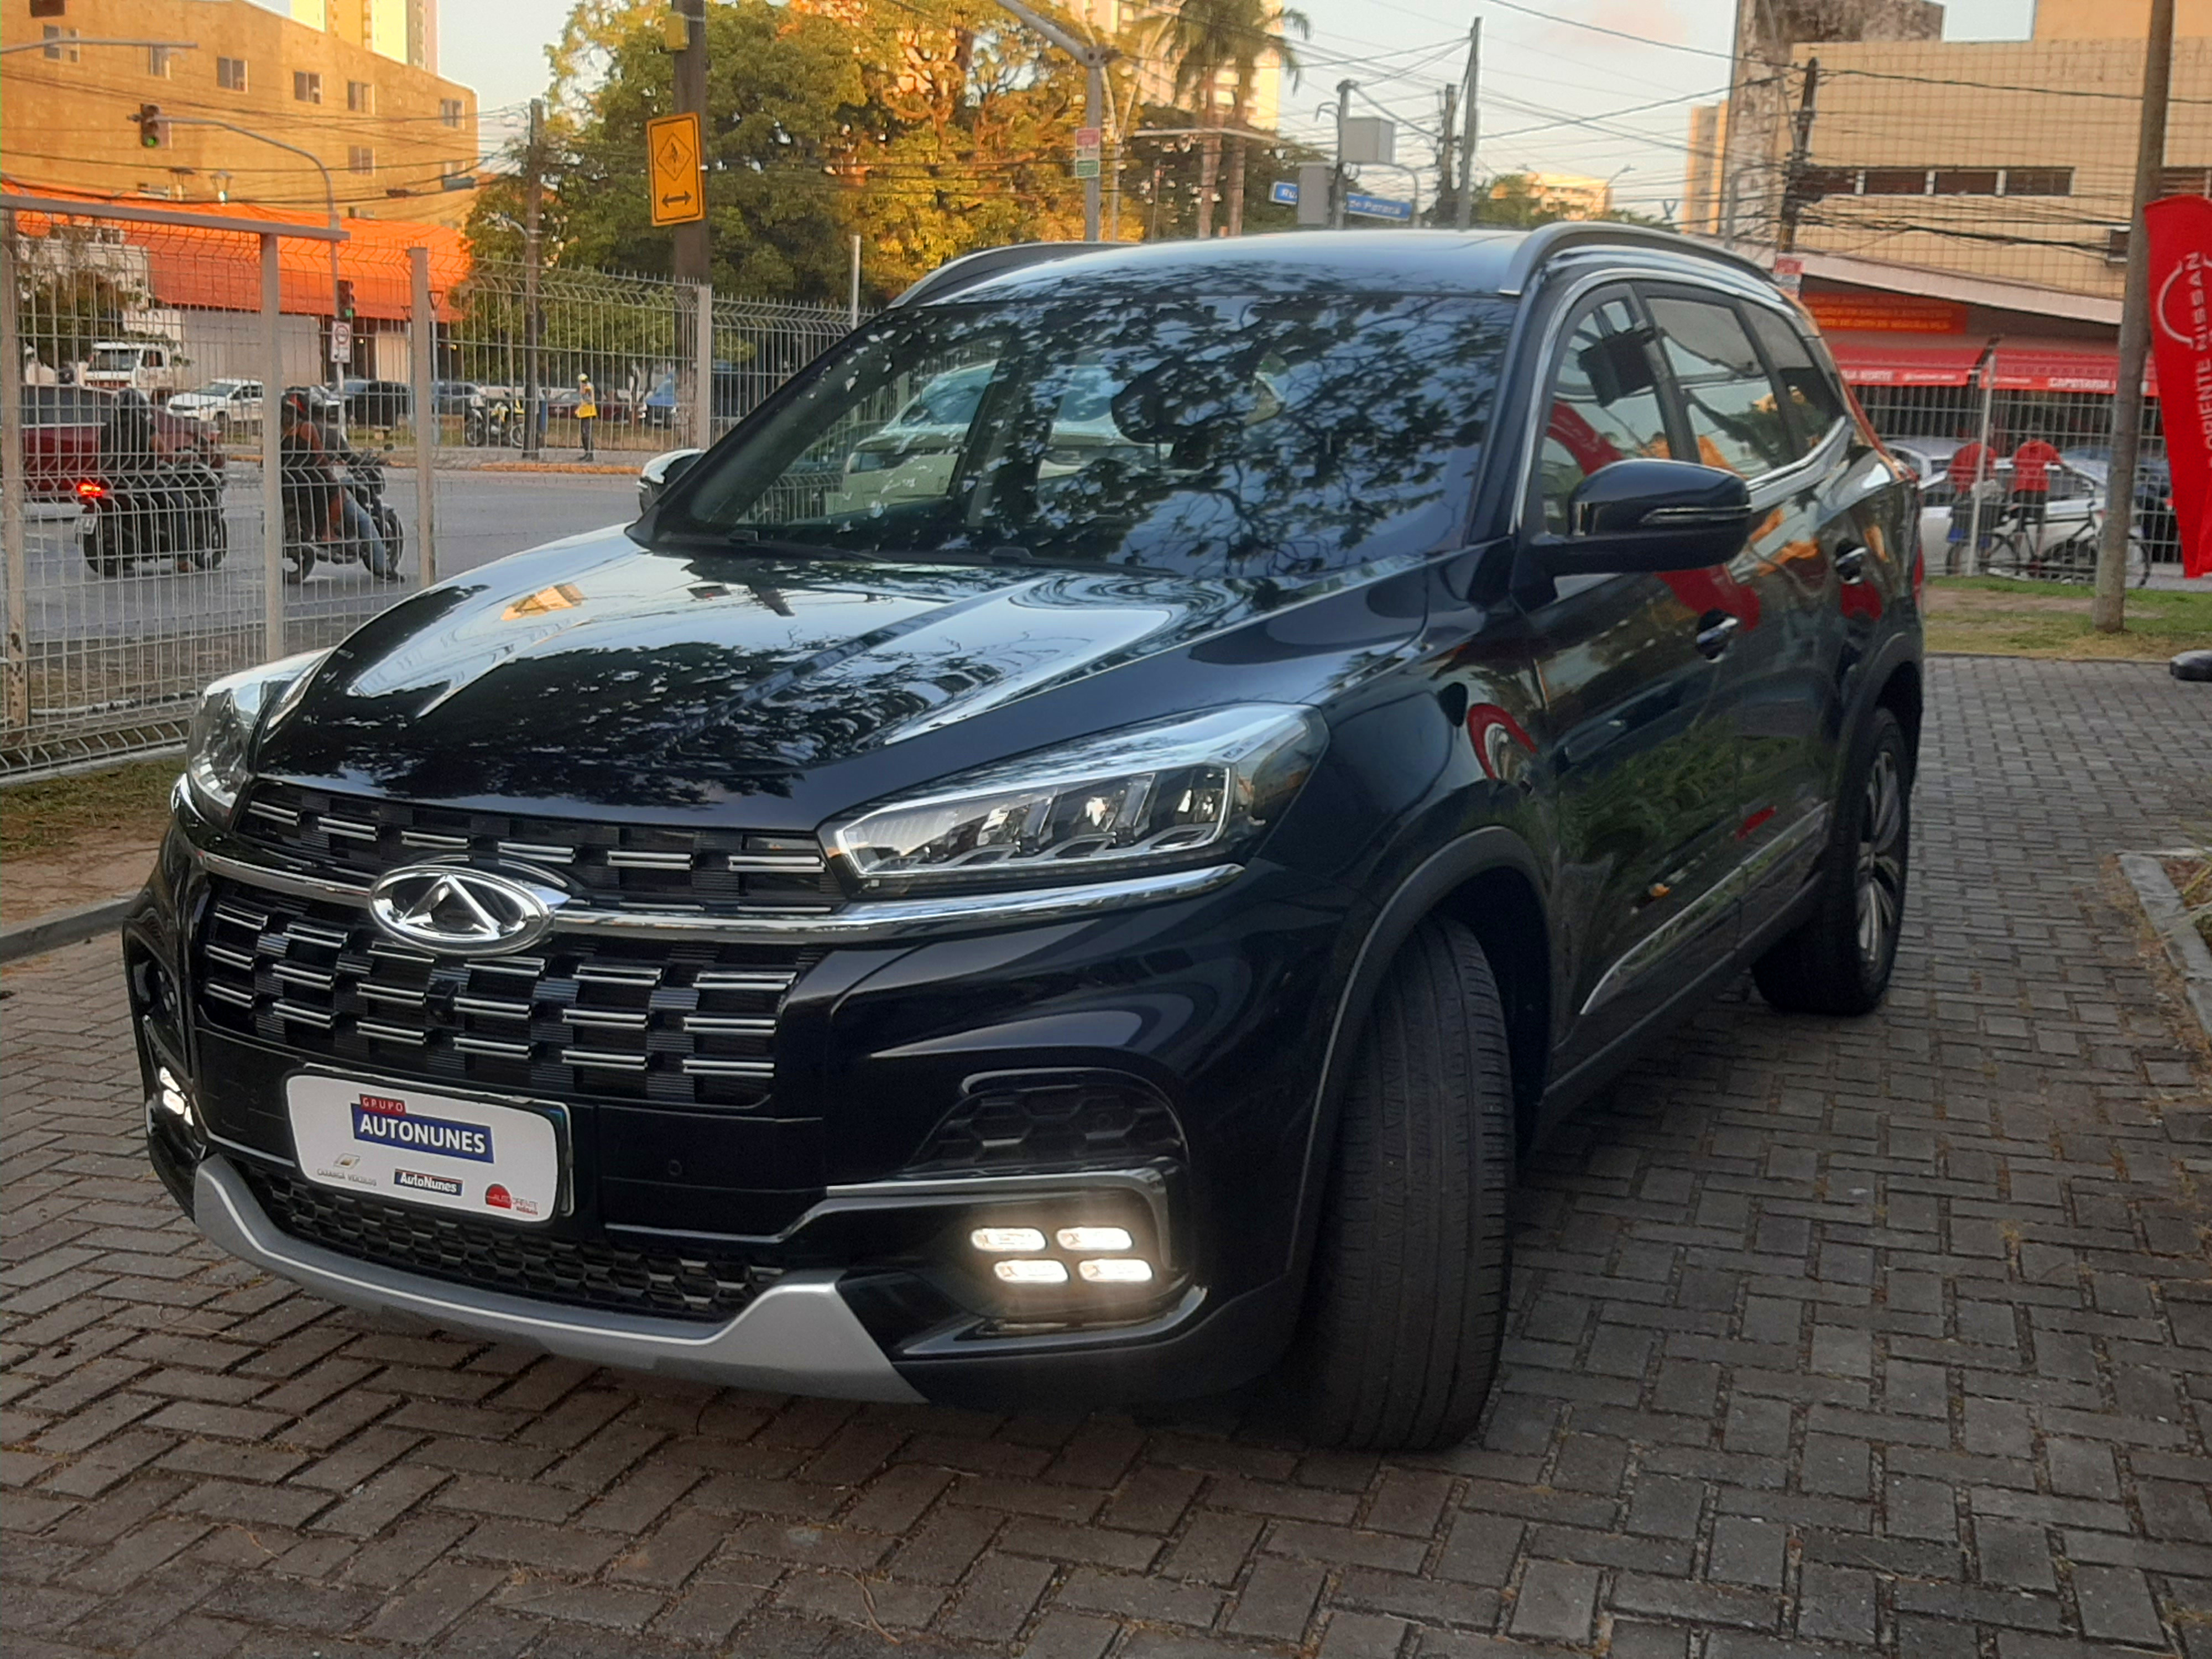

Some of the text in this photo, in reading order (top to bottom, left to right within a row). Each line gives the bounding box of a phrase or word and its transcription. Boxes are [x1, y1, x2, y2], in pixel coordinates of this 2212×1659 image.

[2184, 252, 2208, 351] NISSAN
[362, 1097, 404, 1113] GRUPO
[359, 1114, 486, 1154] AUTONUNES
[400, 1172, 457, 1193] AutoNunes
